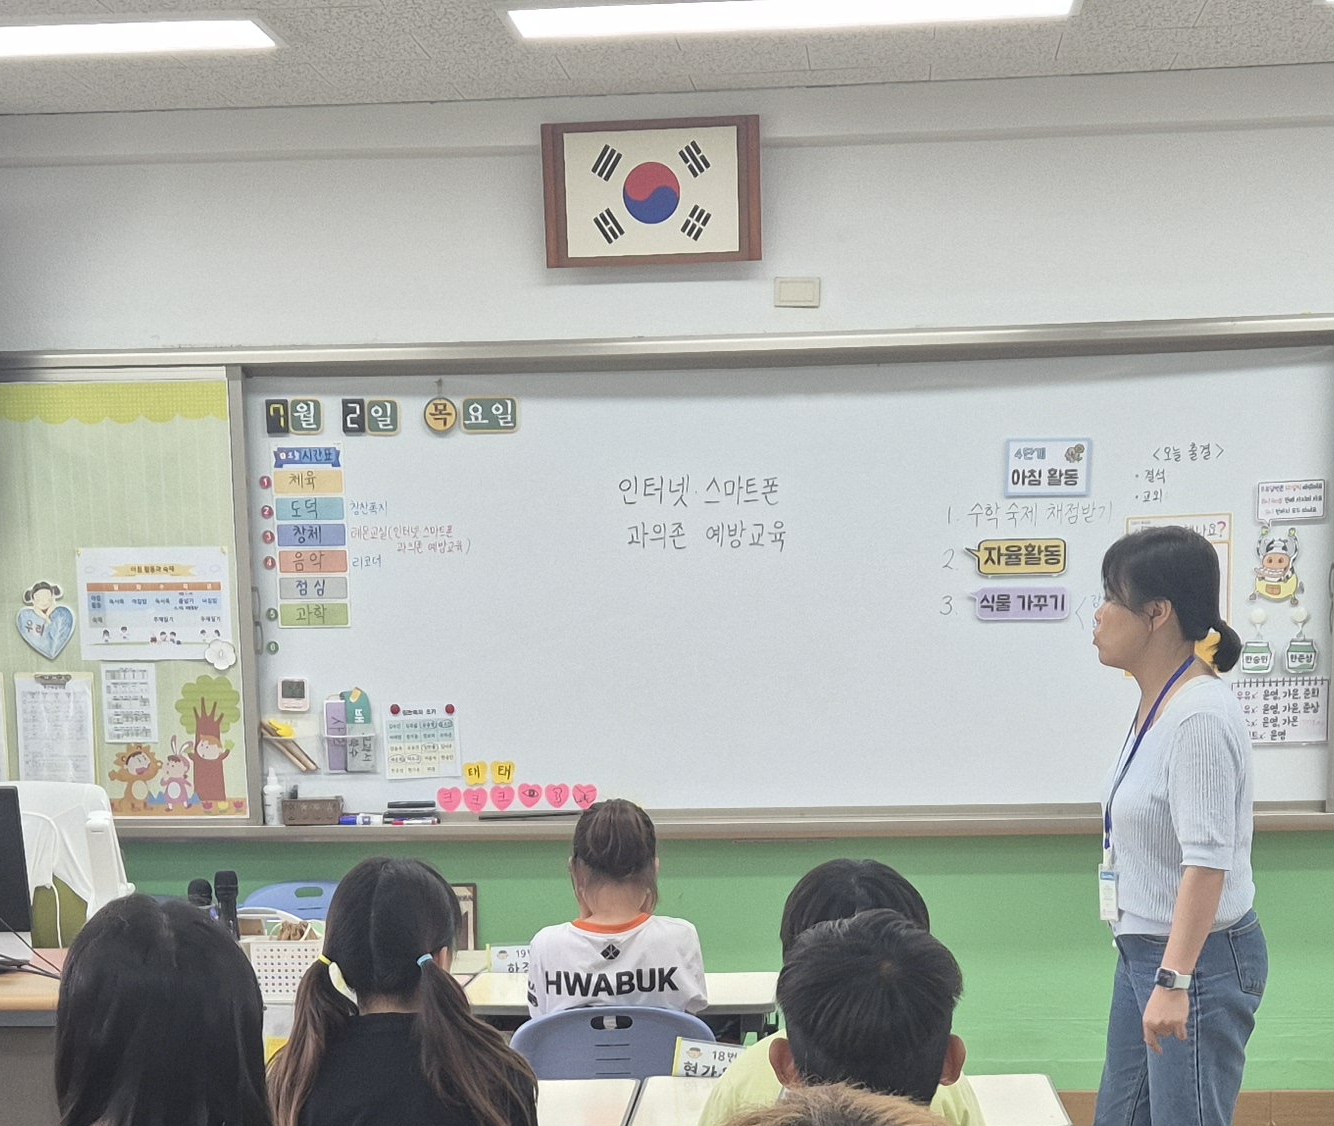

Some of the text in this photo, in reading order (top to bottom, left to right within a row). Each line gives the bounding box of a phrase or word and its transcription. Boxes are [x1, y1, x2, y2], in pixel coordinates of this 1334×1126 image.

[302, 449, 333, 462] 시간표
[1014, 447, 1047, 460] 4단계
[289, 470, 316, 490] 체육
[1011, 467, 1079, 487] 아침 활동
[705, 476, 780, 505] 스마트폰
[291, 498, 318, 519] 도덕
[968, 502, 1000, 529] 수학
[1005, 502, 1038, 529] 숙제
[1046, 501, 1114, 526] 채점받기
[293, 525, 322, 545] 창체
[628, 521, 788, 551] 과의존 예방교육
[292, 552, 325, 572] 음악
[351, 555, 382, 570] 리코더
[982, 543, 1062, 567] 자율활동
[980, 593, 1066, 612] 식물 가꾸기
[295, 604, 327, 625] 과학
[24, 620, 45, 638] 우리
[545, 966, 679, 998] HWABUK
